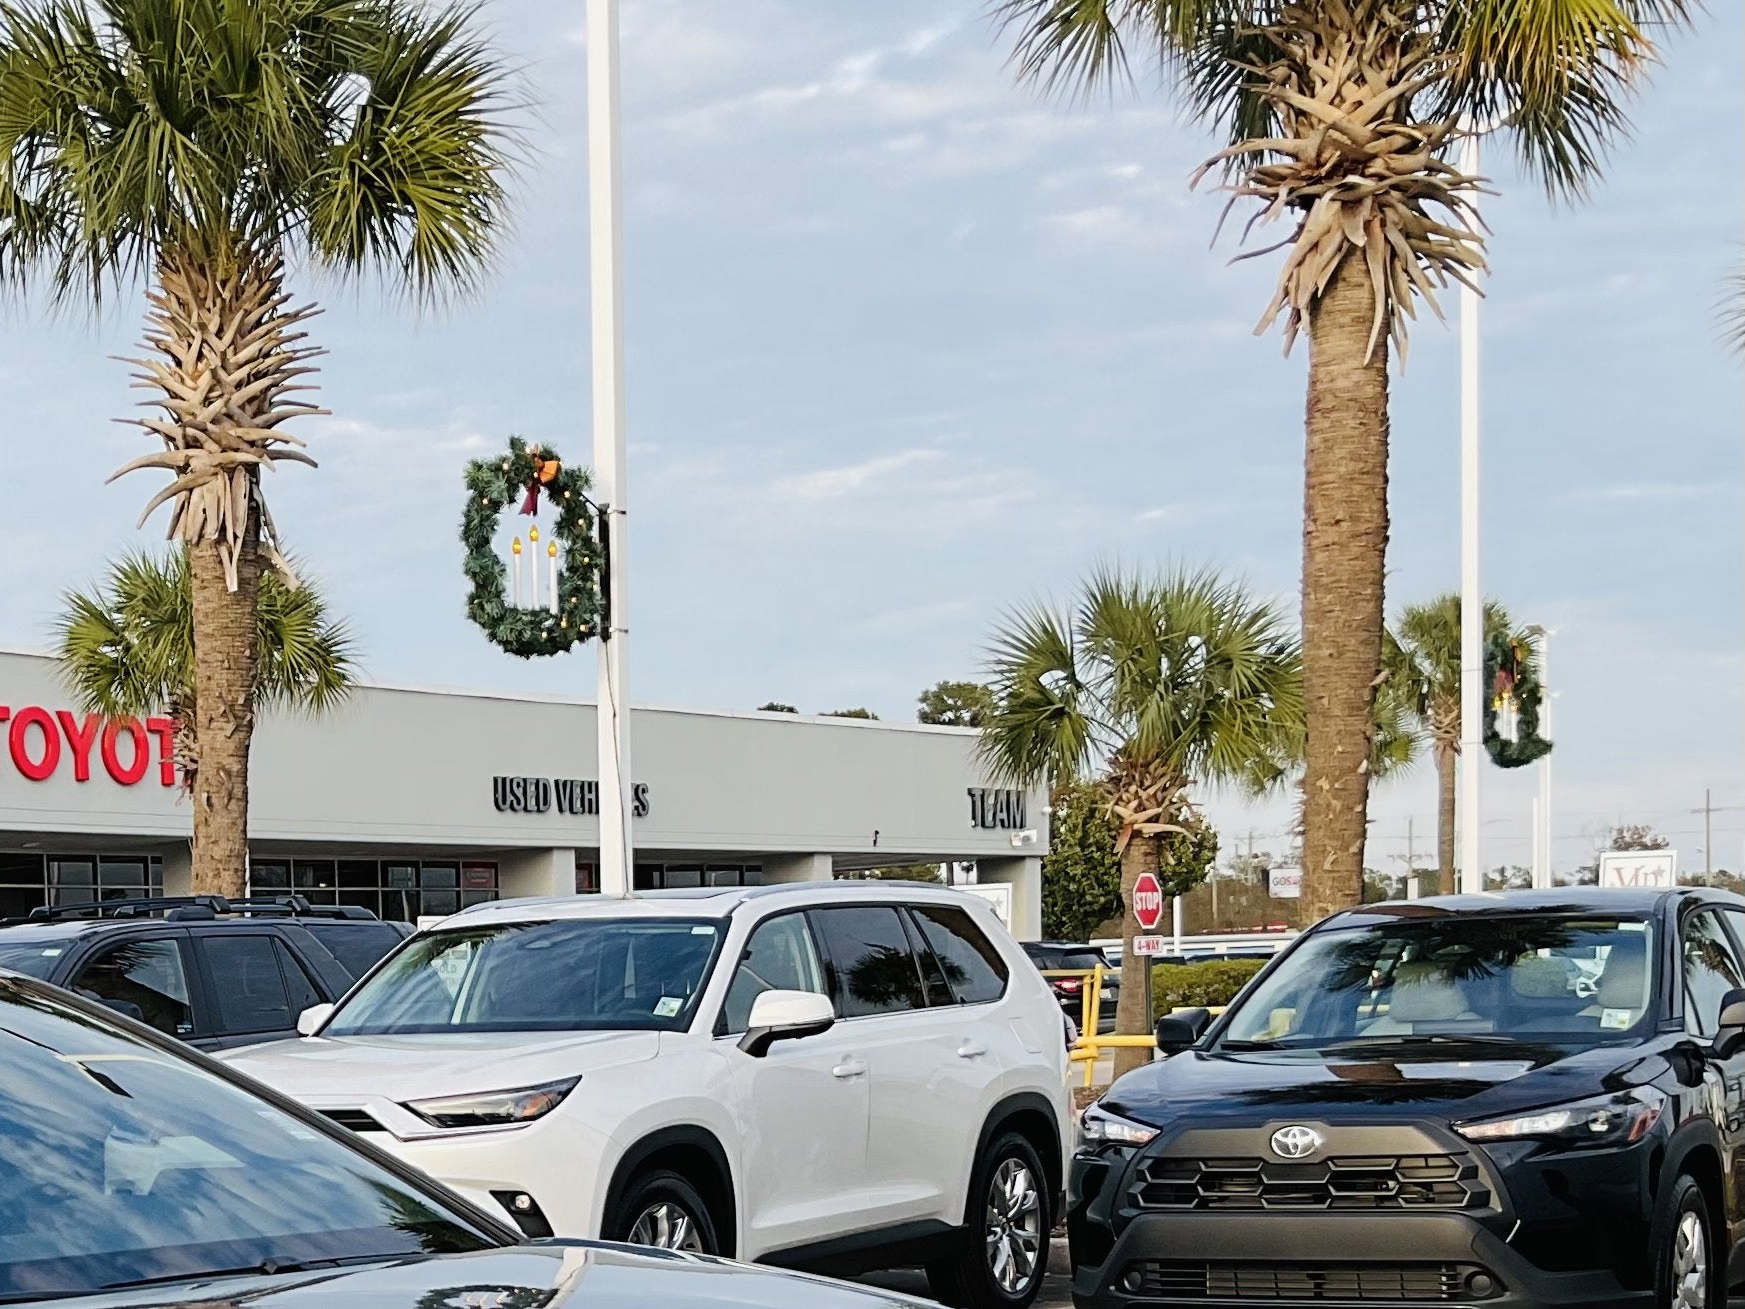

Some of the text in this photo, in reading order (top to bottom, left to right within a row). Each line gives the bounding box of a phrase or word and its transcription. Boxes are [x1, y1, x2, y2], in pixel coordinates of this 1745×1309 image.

[493, 776, 551, 812] USED
[967, 787, 1027, 829] TEAM
[1135, 891, 1159, 911] STOP
[1137, 939, 1160, 952] 4-WAY
